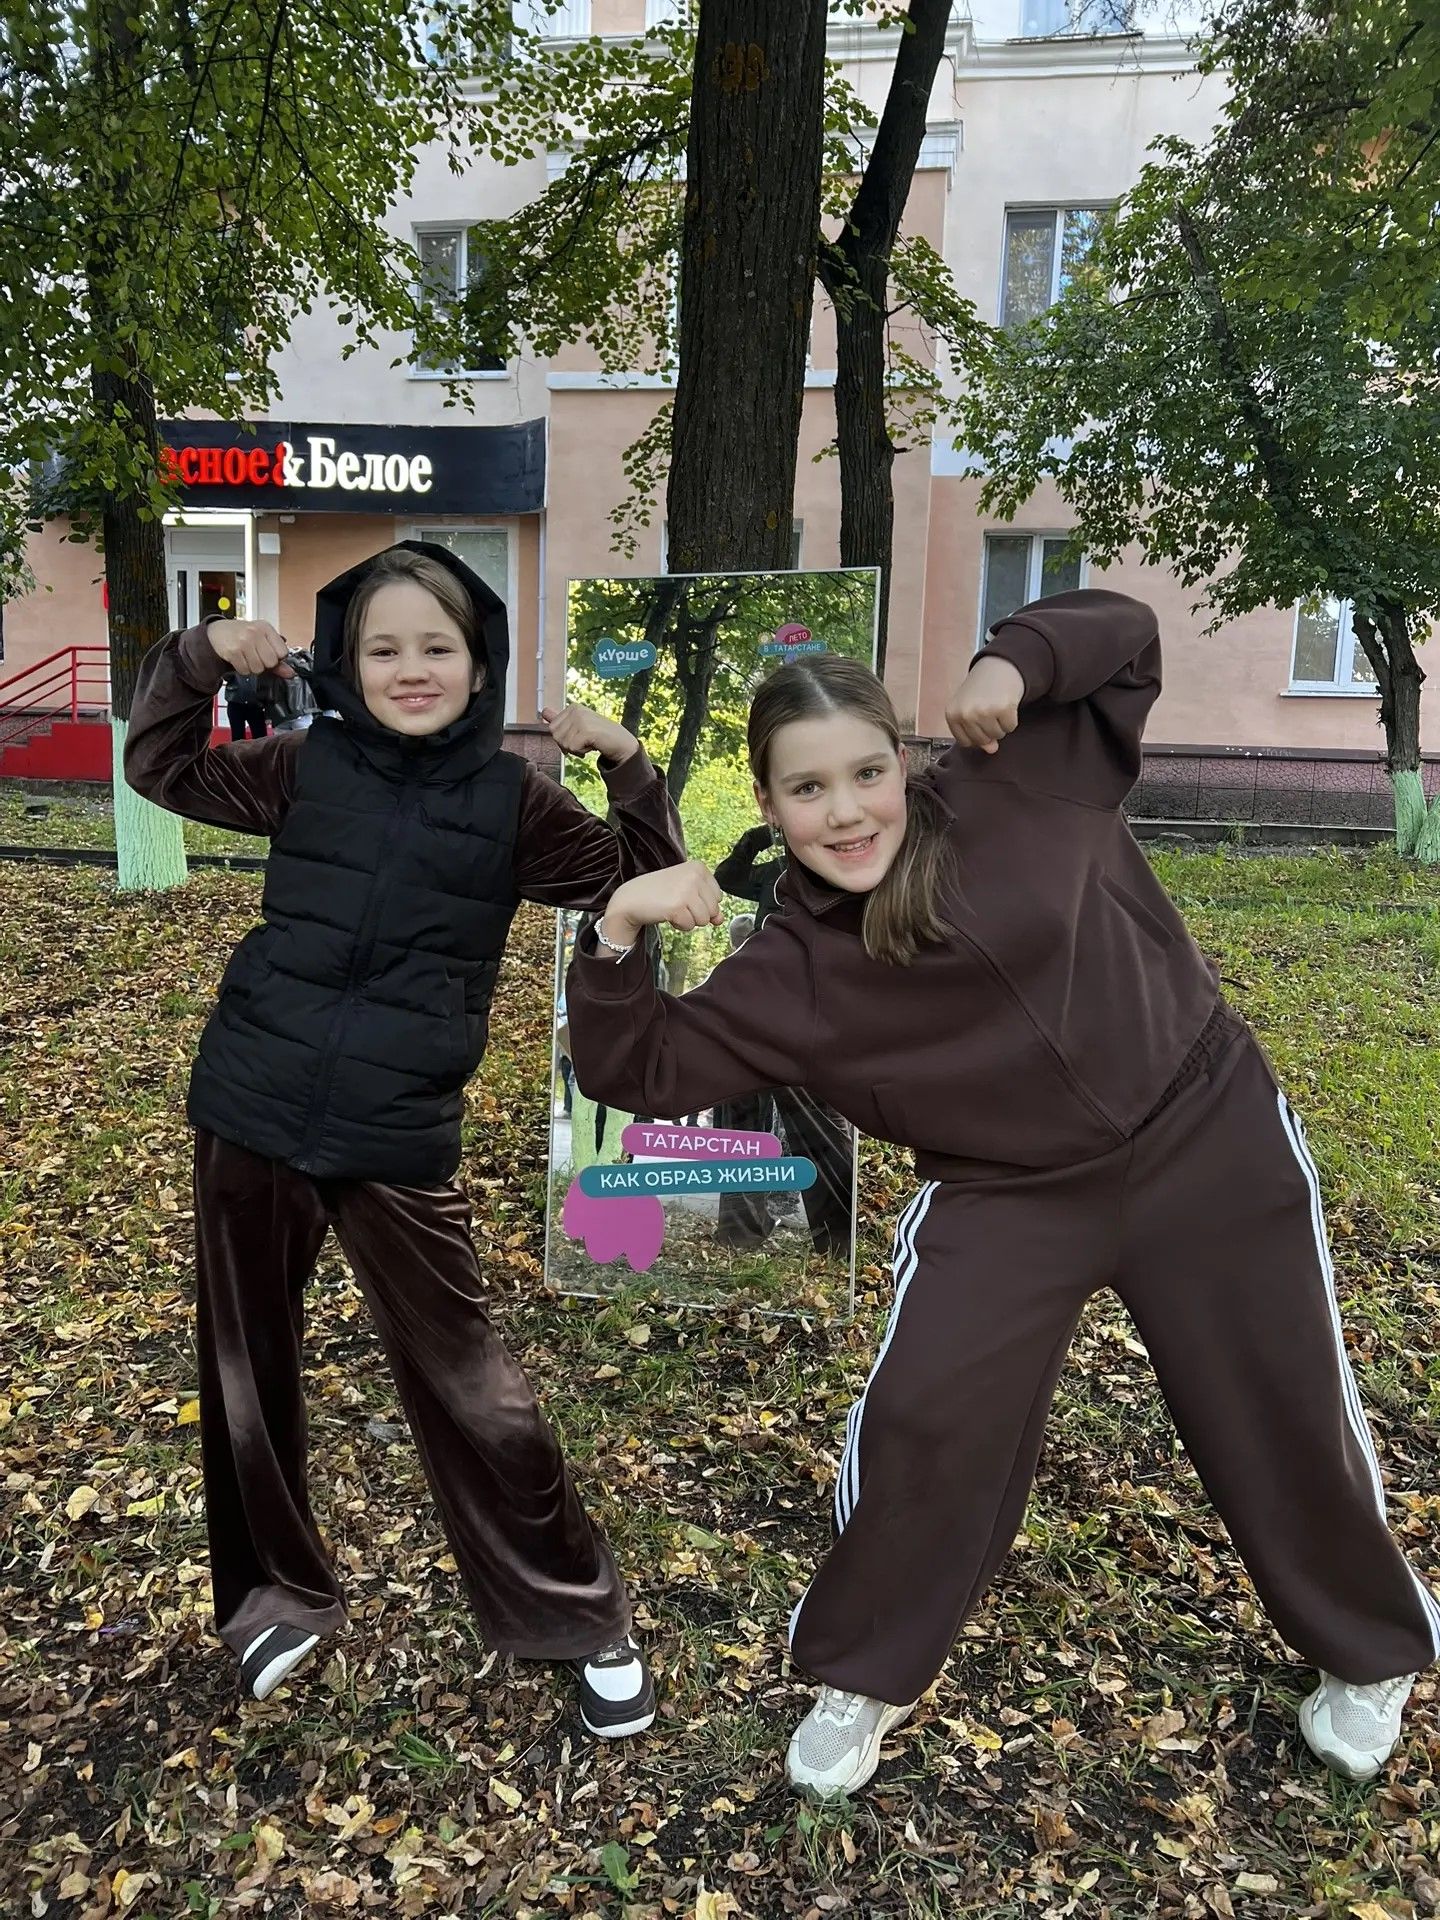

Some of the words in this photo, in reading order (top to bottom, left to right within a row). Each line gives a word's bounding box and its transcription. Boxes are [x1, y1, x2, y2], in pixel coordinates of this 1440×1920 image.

[789, 631, 808, 642] ЛЕТО
[774, 643, 821, 652] ТАТАРСТАНЕ
[642, 1132, 760, 1156] ТАТАРСТАН
[600, 1172, 640, 1189] КАК
[644, 1168, 713, 1187] ОБРАЗ
[717, 1165, 795, 1183] ЖИЗНИ
